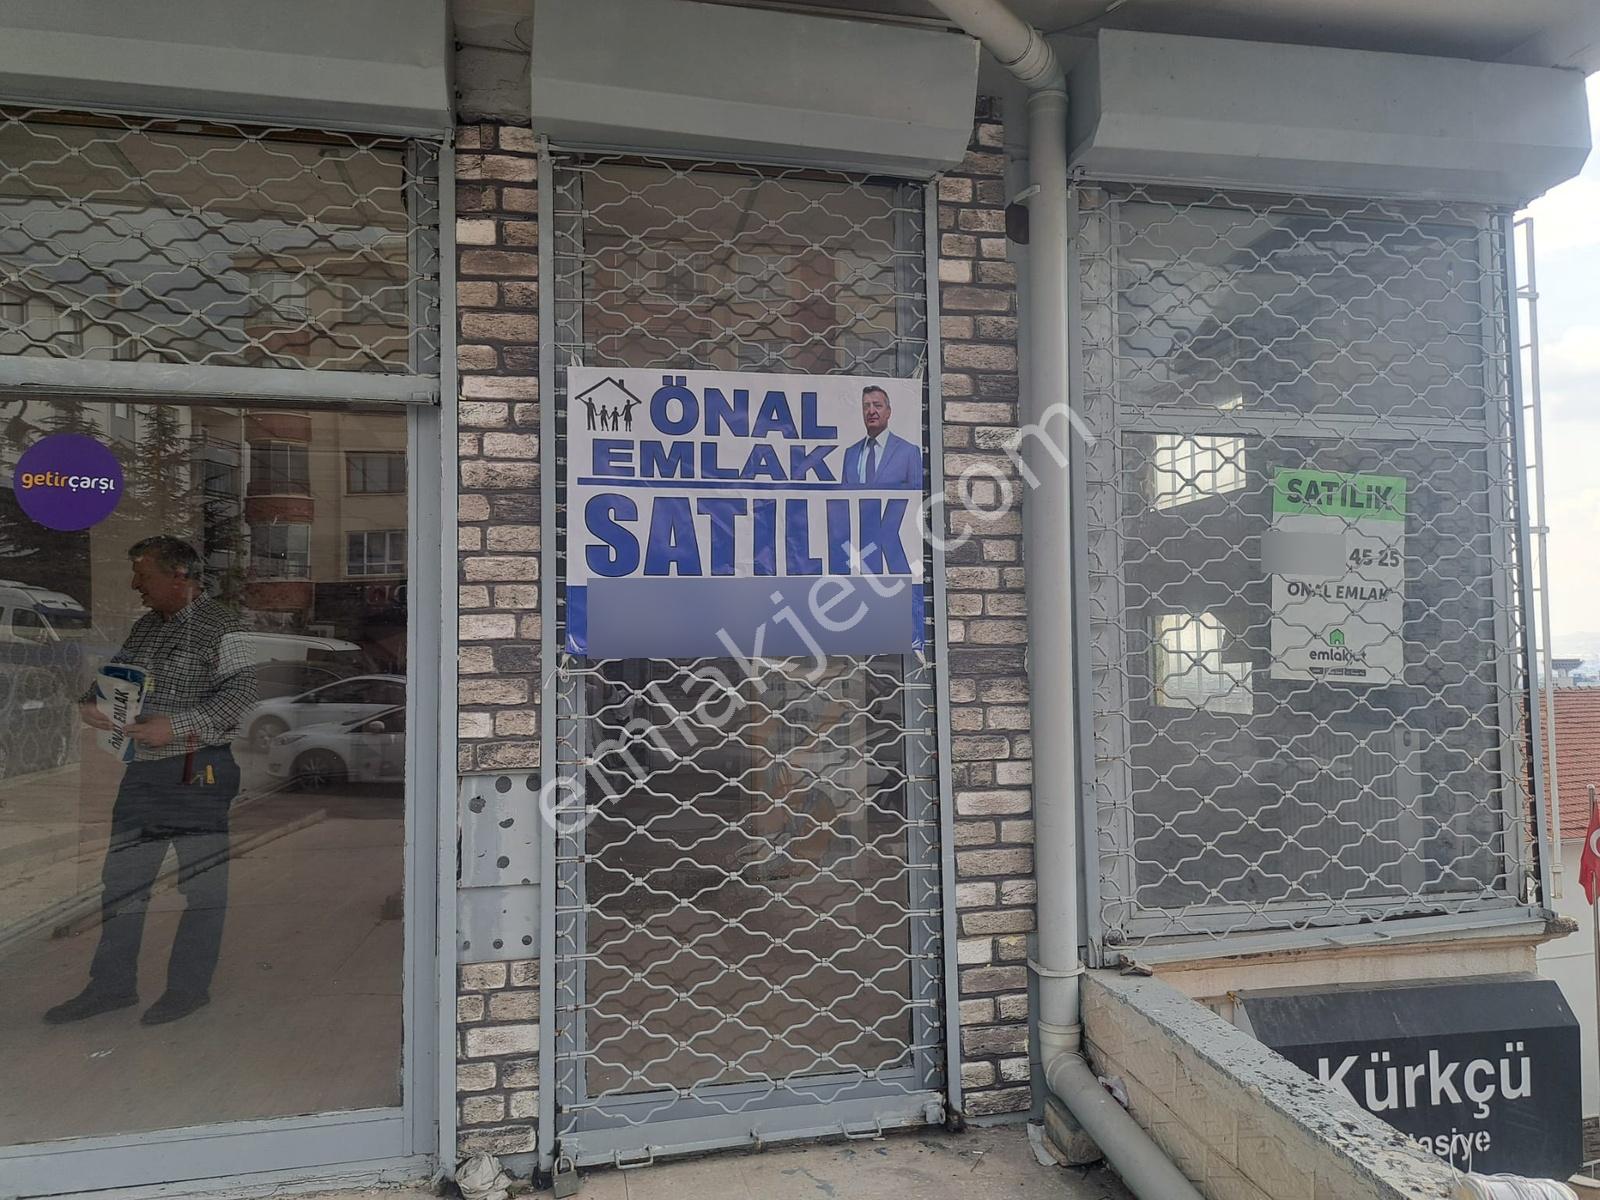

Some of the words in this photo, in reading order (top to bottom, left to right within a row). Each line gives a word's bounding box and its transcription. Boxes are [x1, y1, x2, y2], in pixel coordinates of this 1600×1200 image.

[649, 375, 838, 439] ÖNAL
[592, 438, 839, 481] EMLAK
[584, 492, 912, 577] SATILIK
[1318, 1041, 1531, 1119] Kürkçü
